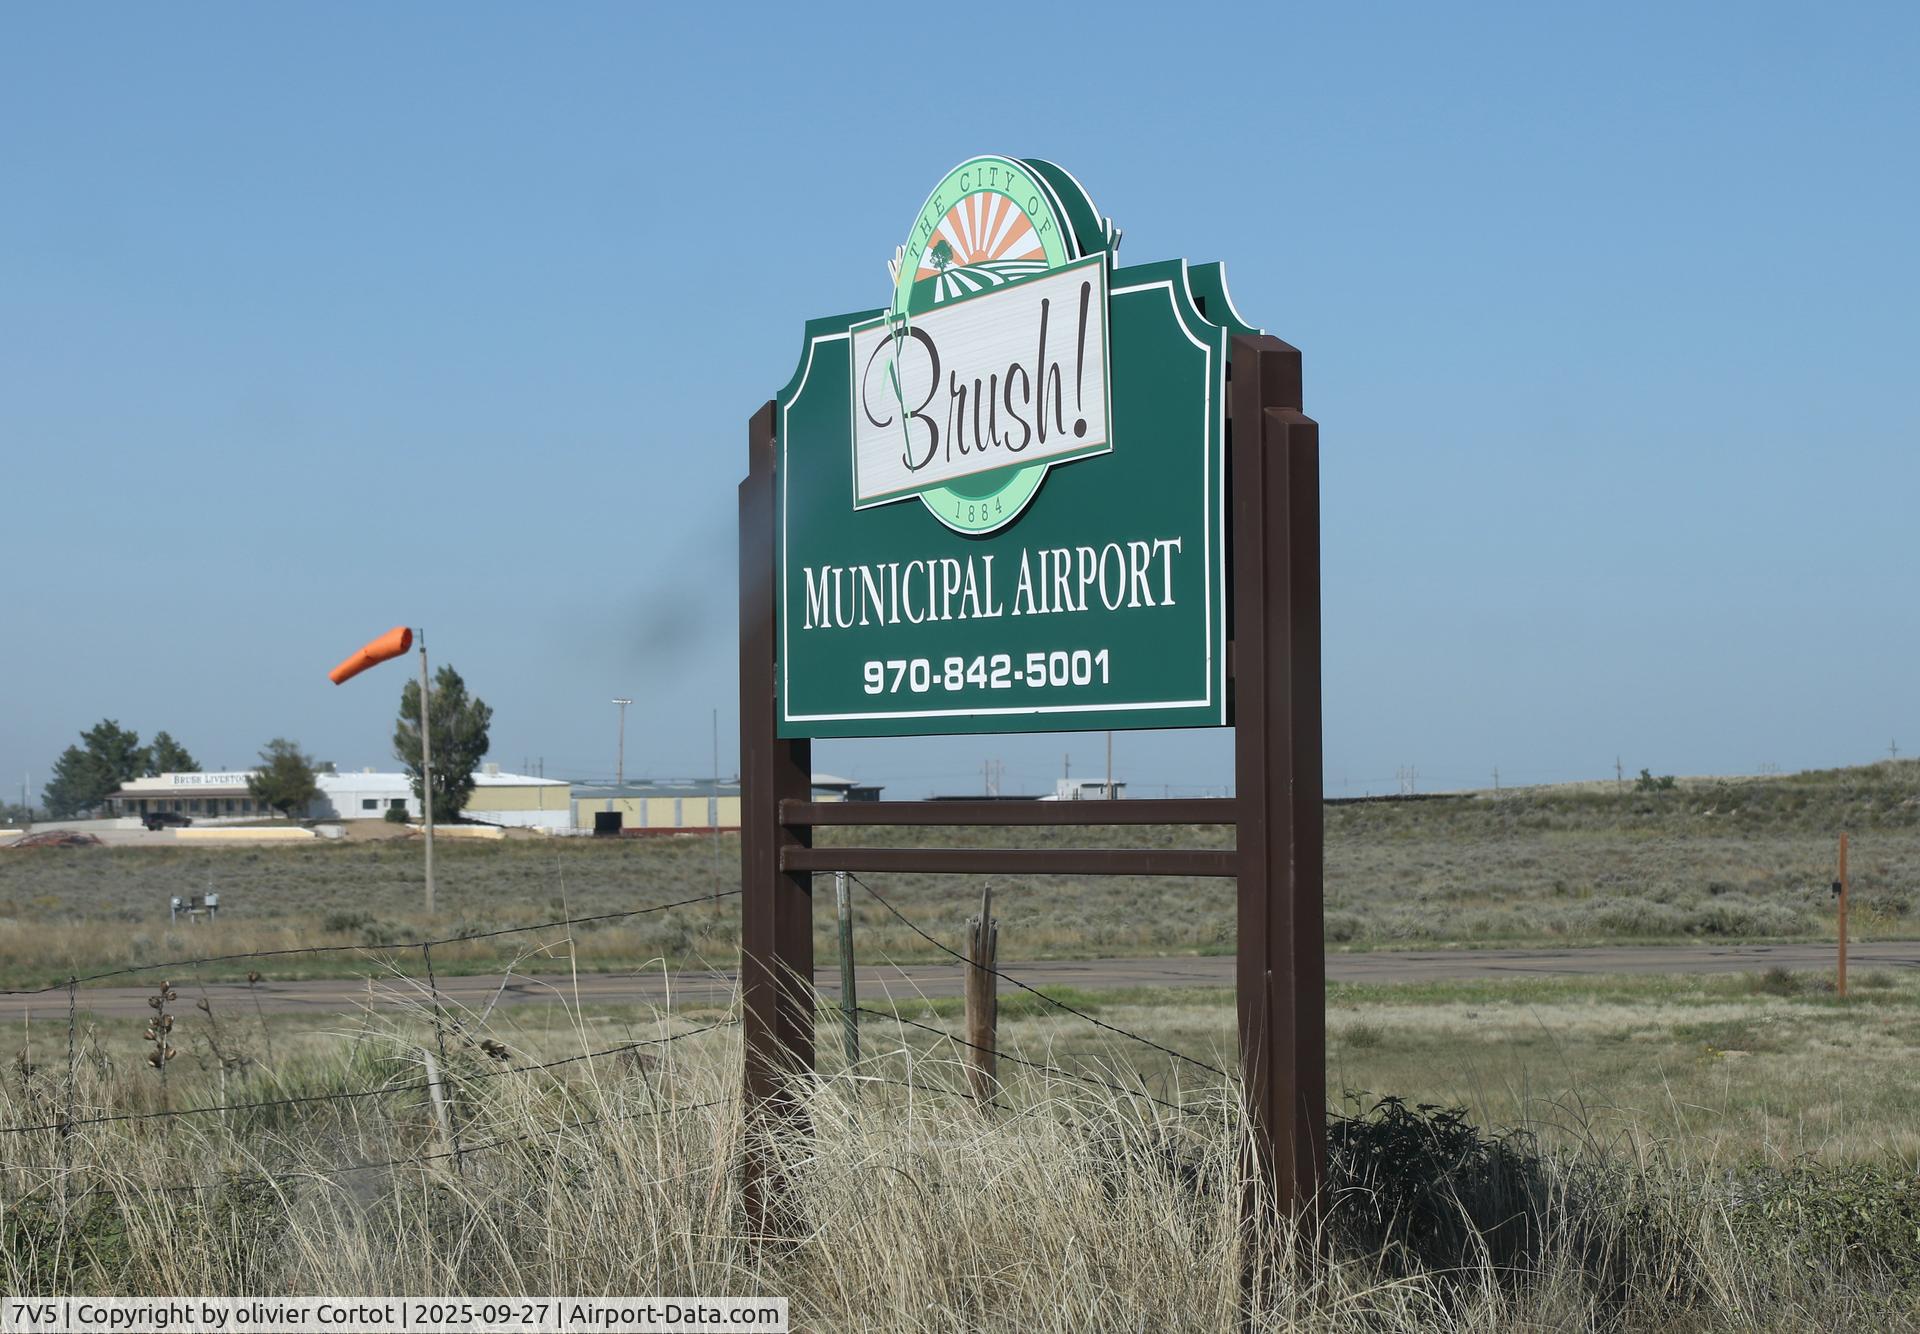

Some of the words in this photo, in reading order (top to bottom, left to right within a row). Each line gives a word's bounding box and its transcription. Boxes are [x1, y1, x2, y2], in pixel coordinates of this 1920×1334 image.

[910, 194, 945, 260] THE
[960, 167, 1015, 193] CITY
[1028, 196, 1052, 235] OF
[862, 281, 1091, 471] Brush!
[955, 496, 1002, 523] 1884
[803, 554, 1004, 630] MUNICIPAL
[1011, 536, 1182, 616] AIRPORT
